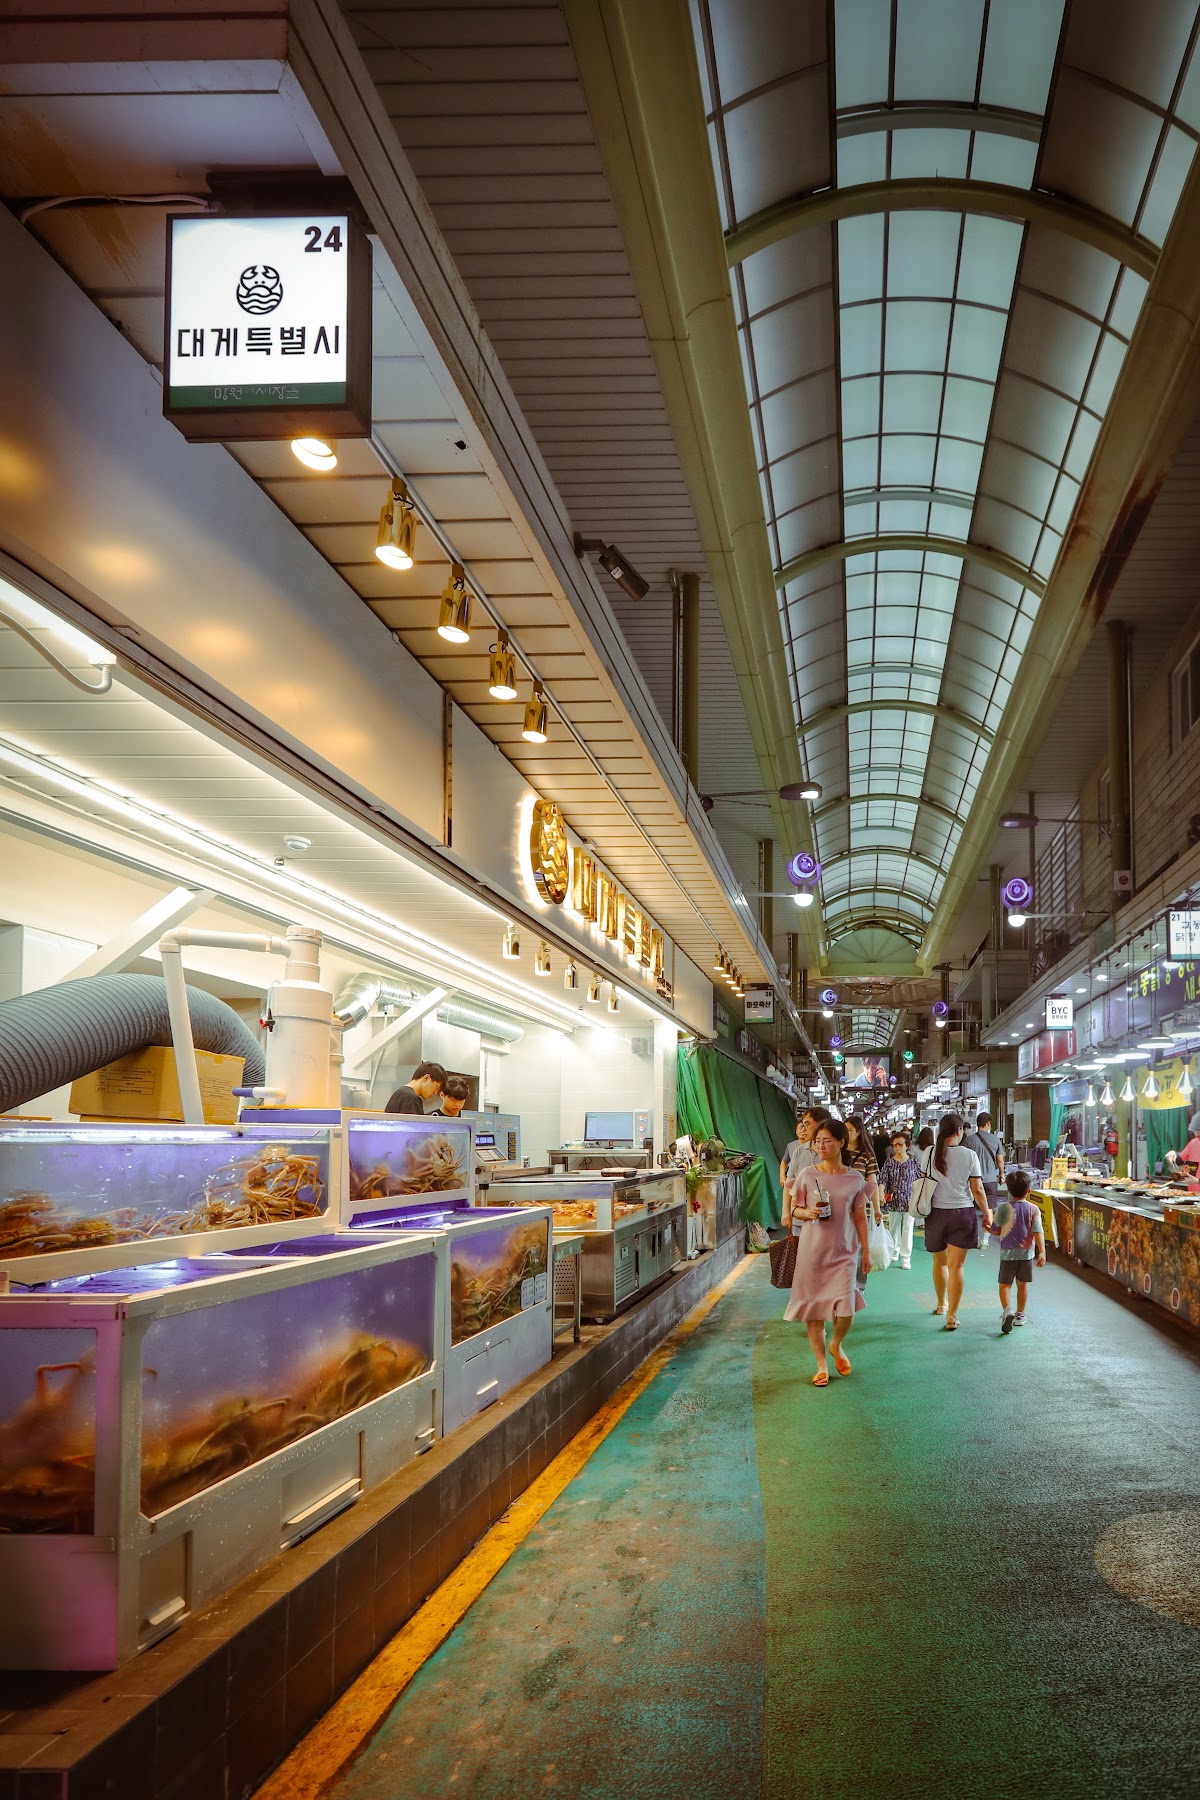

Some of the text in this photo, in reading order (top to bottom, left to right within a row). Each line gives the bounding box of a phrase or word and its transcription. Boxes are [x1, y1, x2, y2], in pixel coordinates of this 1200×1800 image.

[304, 226, 343, 252] 24
[177, 325, 340, 357] 대게특별시
[1171, 913, 1180, 921] 21
[1051, 1006, 1069, 1015] BYC
